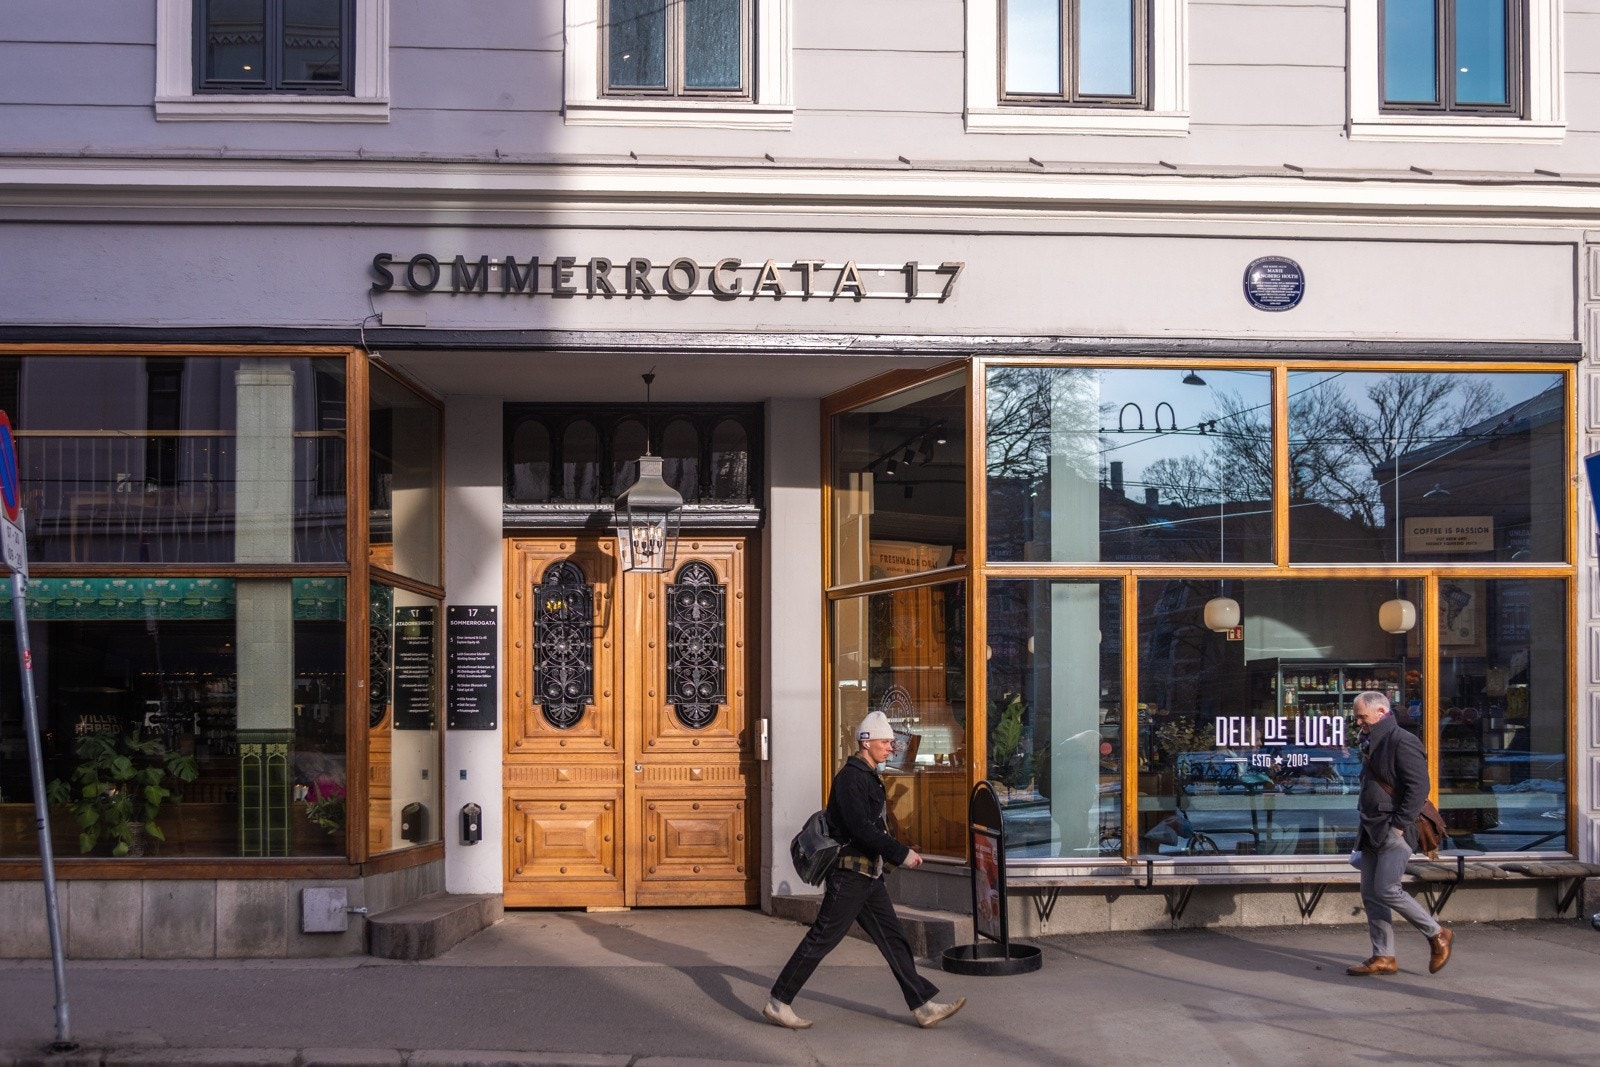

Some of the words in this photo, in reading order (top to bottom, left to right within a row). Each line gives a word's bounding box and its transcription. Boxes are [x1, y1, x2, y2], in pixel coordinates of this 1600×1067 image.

[371, 253, 867, 298] SOMMERROGATA
[902, 260, 966, 301] 17
[880, 554, 920, 567] FRESHMADE
[468, 608, 478, 616] 17
[1216, 716, 1256, 746] DELI
[1264, 716, 1288, 740] DE
[1295, 716, 1344, 746] LUCA
[1286, 753, 1309, 768] 2003
